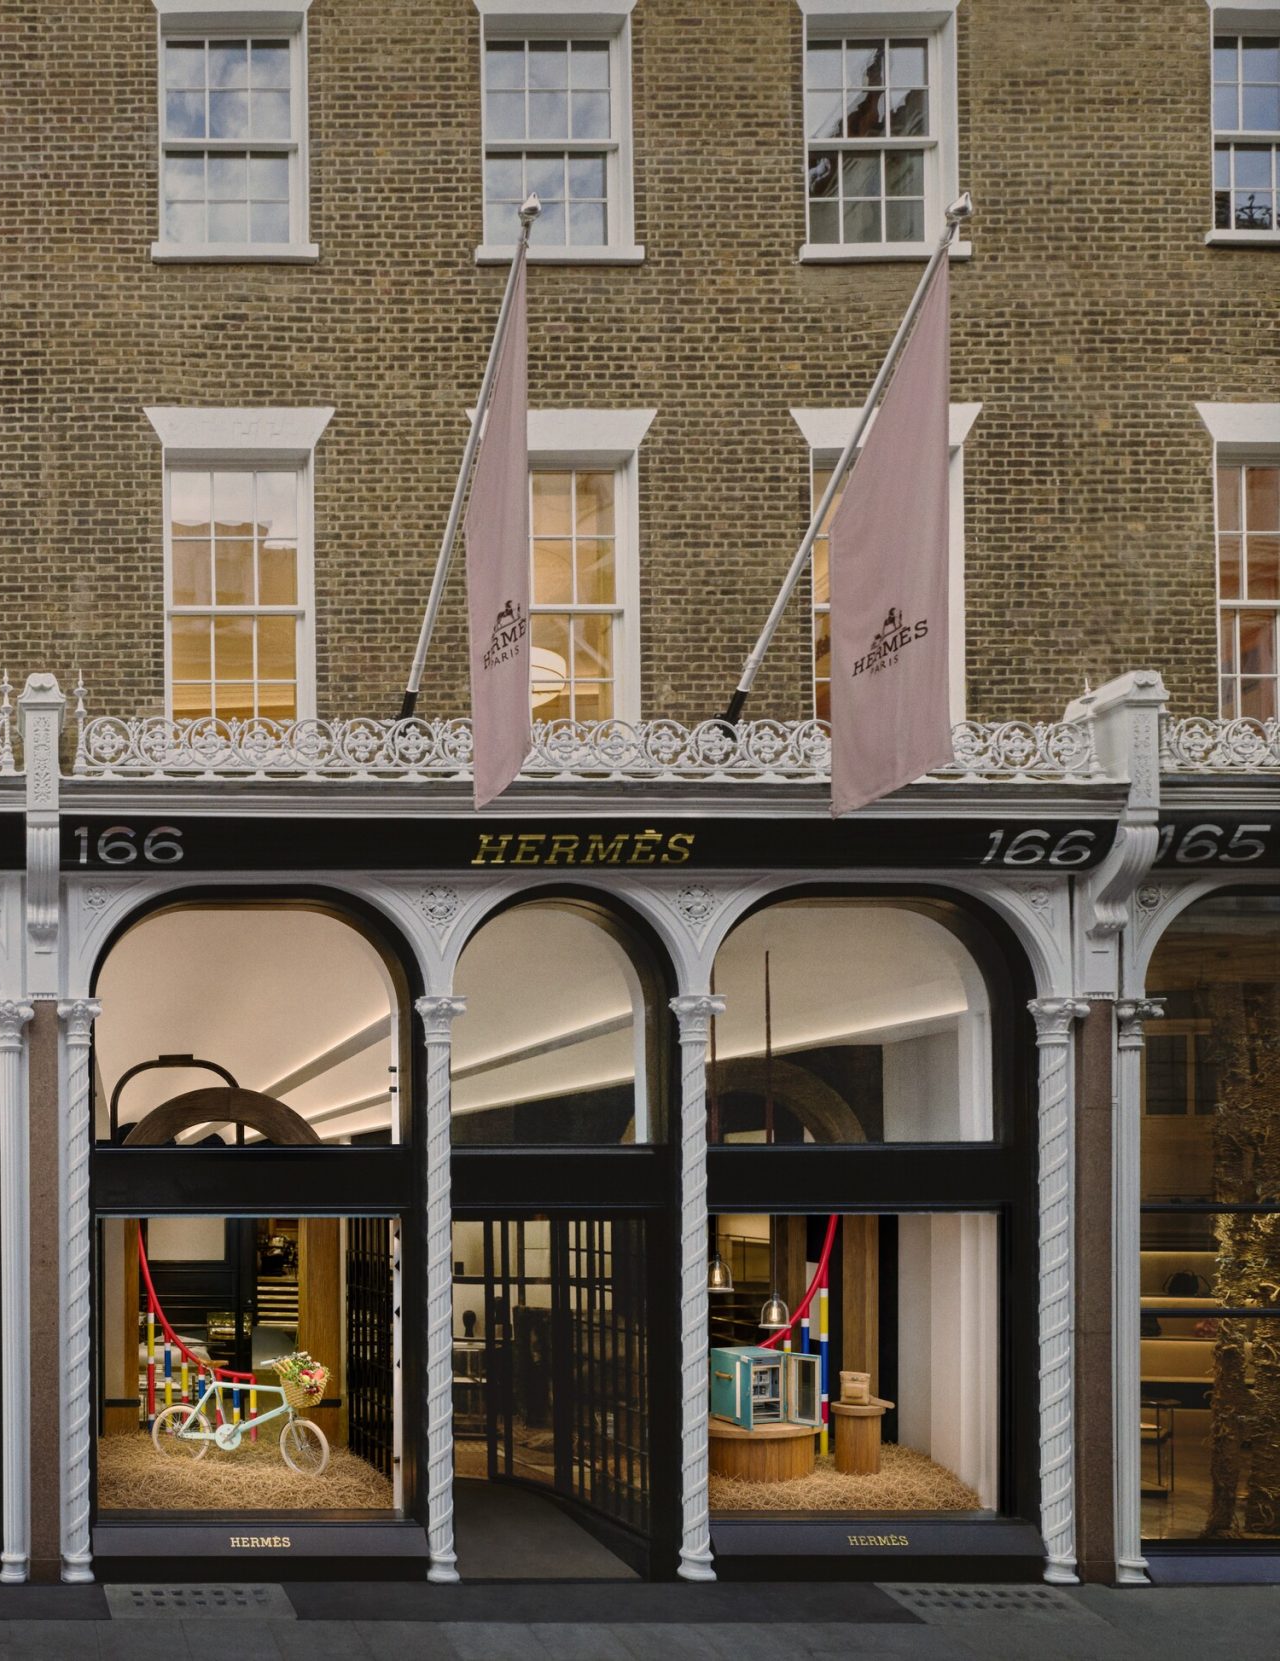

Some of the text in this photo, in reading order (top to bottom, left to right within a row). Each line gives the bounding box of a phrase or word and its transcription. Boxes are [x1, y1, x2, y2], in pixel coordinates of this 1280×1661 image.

[74, 826, 184, 865] 166
[471, 829, 695, 865] HERMÈS
[980, 829, 1096, 866] 166
[1155, 823, 1272, 863] 165
